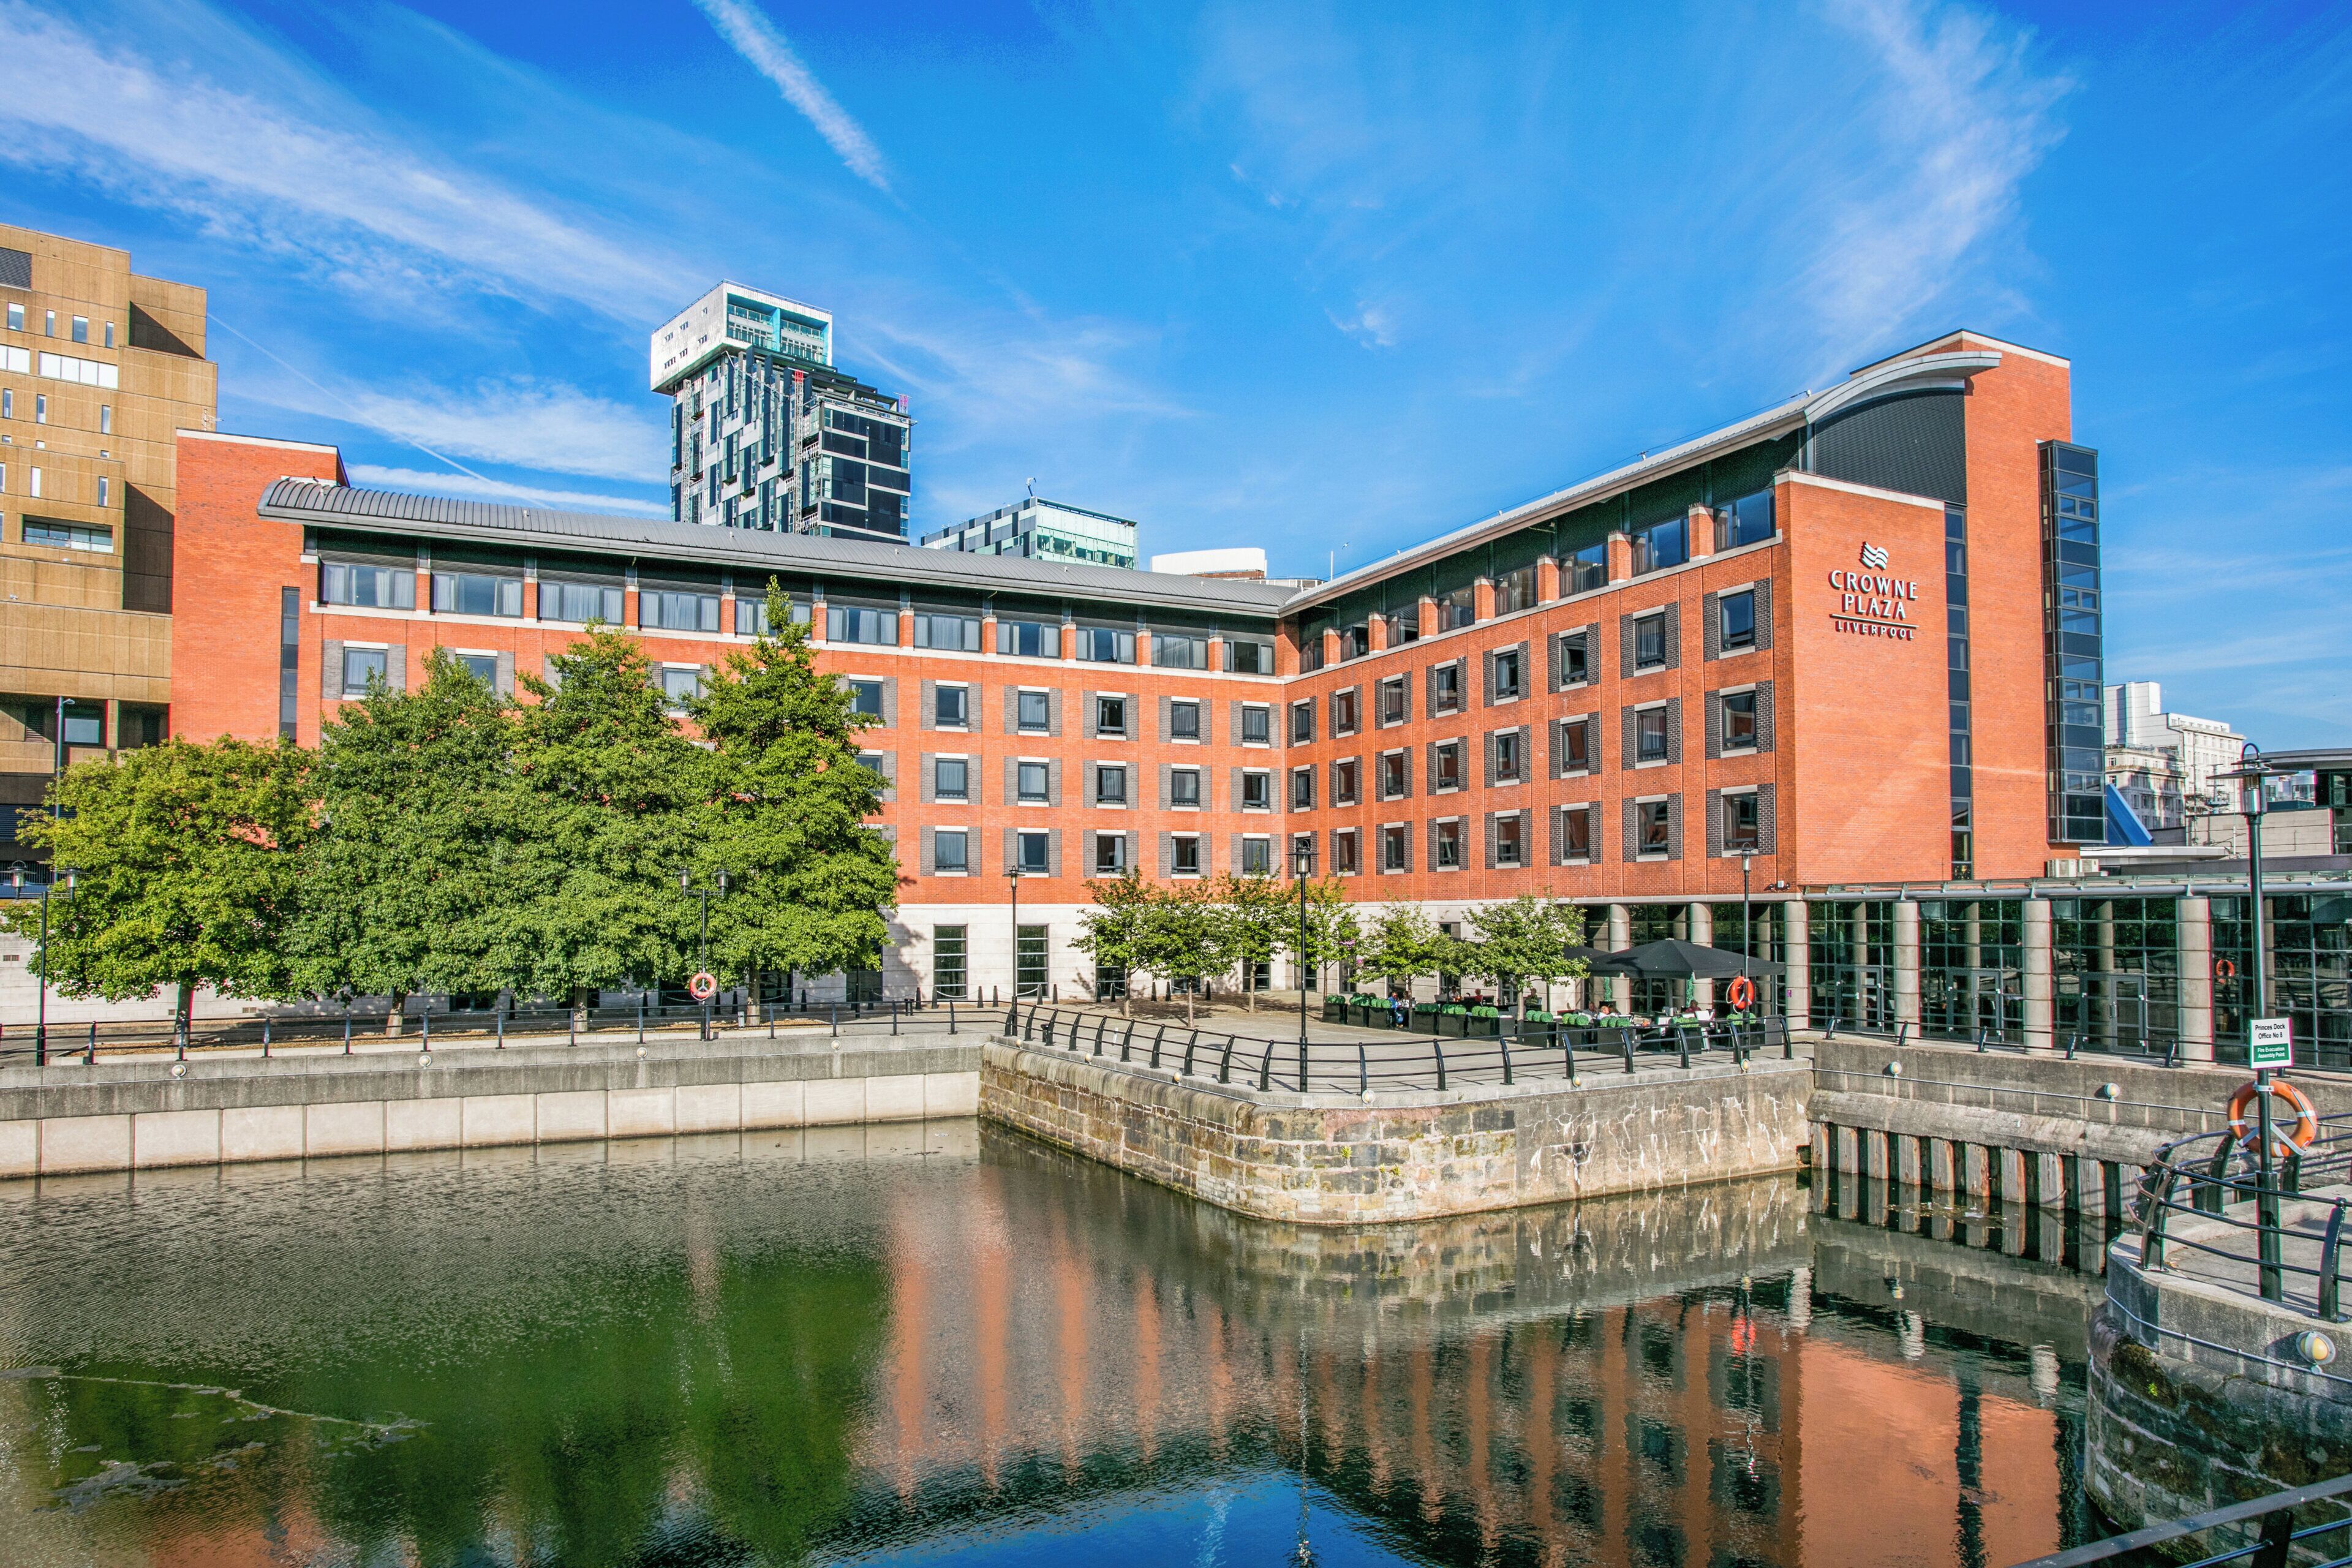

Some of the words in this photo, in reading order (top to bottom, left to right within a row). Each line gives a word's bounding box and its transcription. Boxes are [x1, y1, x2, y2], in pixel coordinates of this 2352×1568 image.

[1829, 570, 1918, 600] CROWNE
[1842, 594, 1906, 619] PLAZA
[1836, 620, 1914, 639] LIVERPOOL
